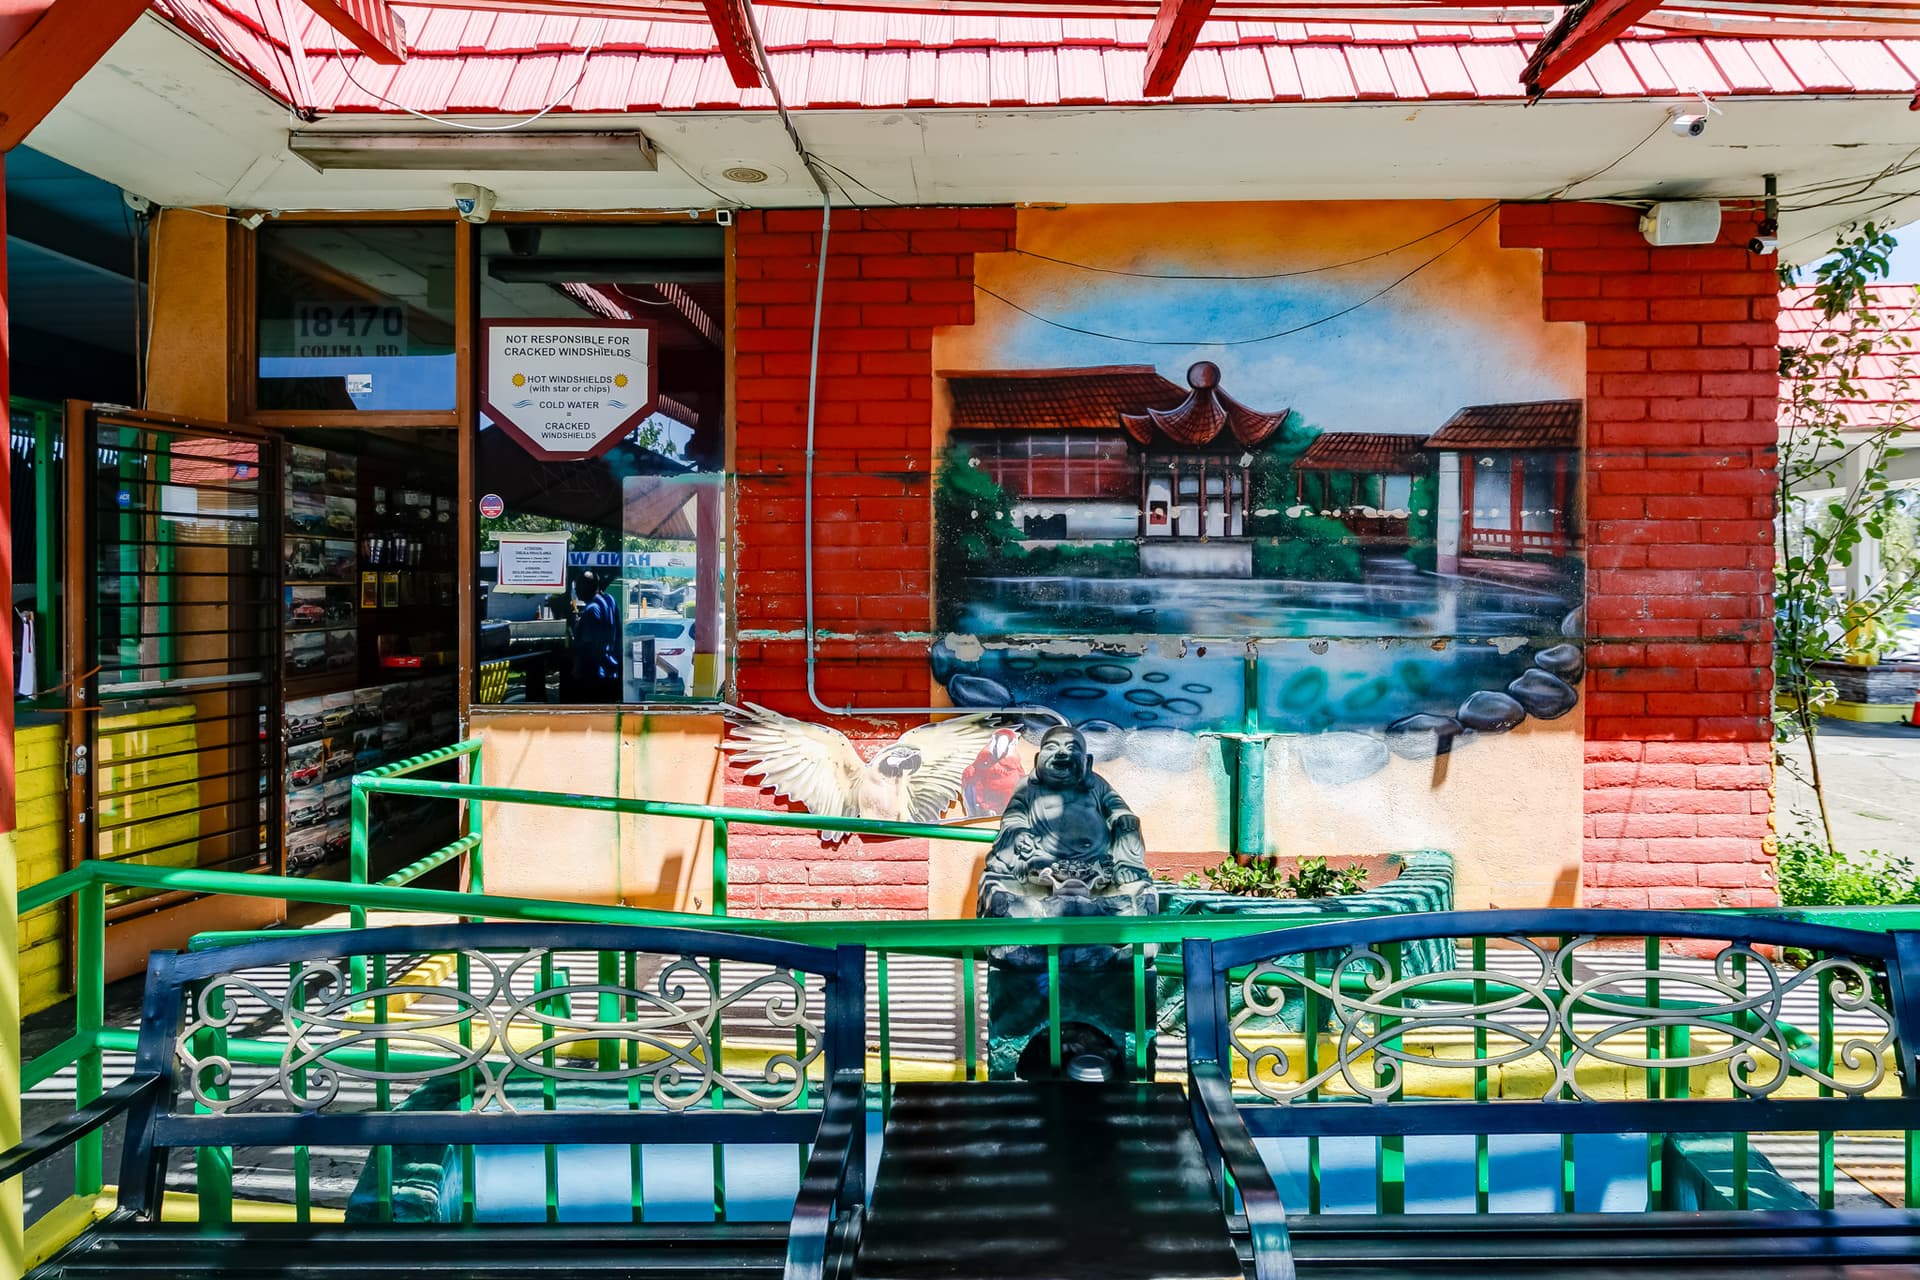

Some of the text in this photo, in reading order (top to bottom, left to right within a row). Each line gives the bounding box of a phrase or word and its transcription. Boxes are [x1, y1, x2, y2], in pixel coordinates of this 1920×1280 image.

[300, 306, 403, 337] 18470
[506, 335, 630, 345] NOT RESPONSIBLE FOR
[300, 345, 402, 357] COLIMA RD.
[504, 348, 631, 358] CRACKED WINDSHIELDS
[527, 376, 613, 384] HOT WINDSHIELDS
[529, 385, 550, 394] (with
[583, 385, 611, 394] chips)
[539, 401, 599, 409] COLD WATER
[545, 422, 590, 430] CRACKED
[541, 432, 597, 440] WINDSHIELDS
